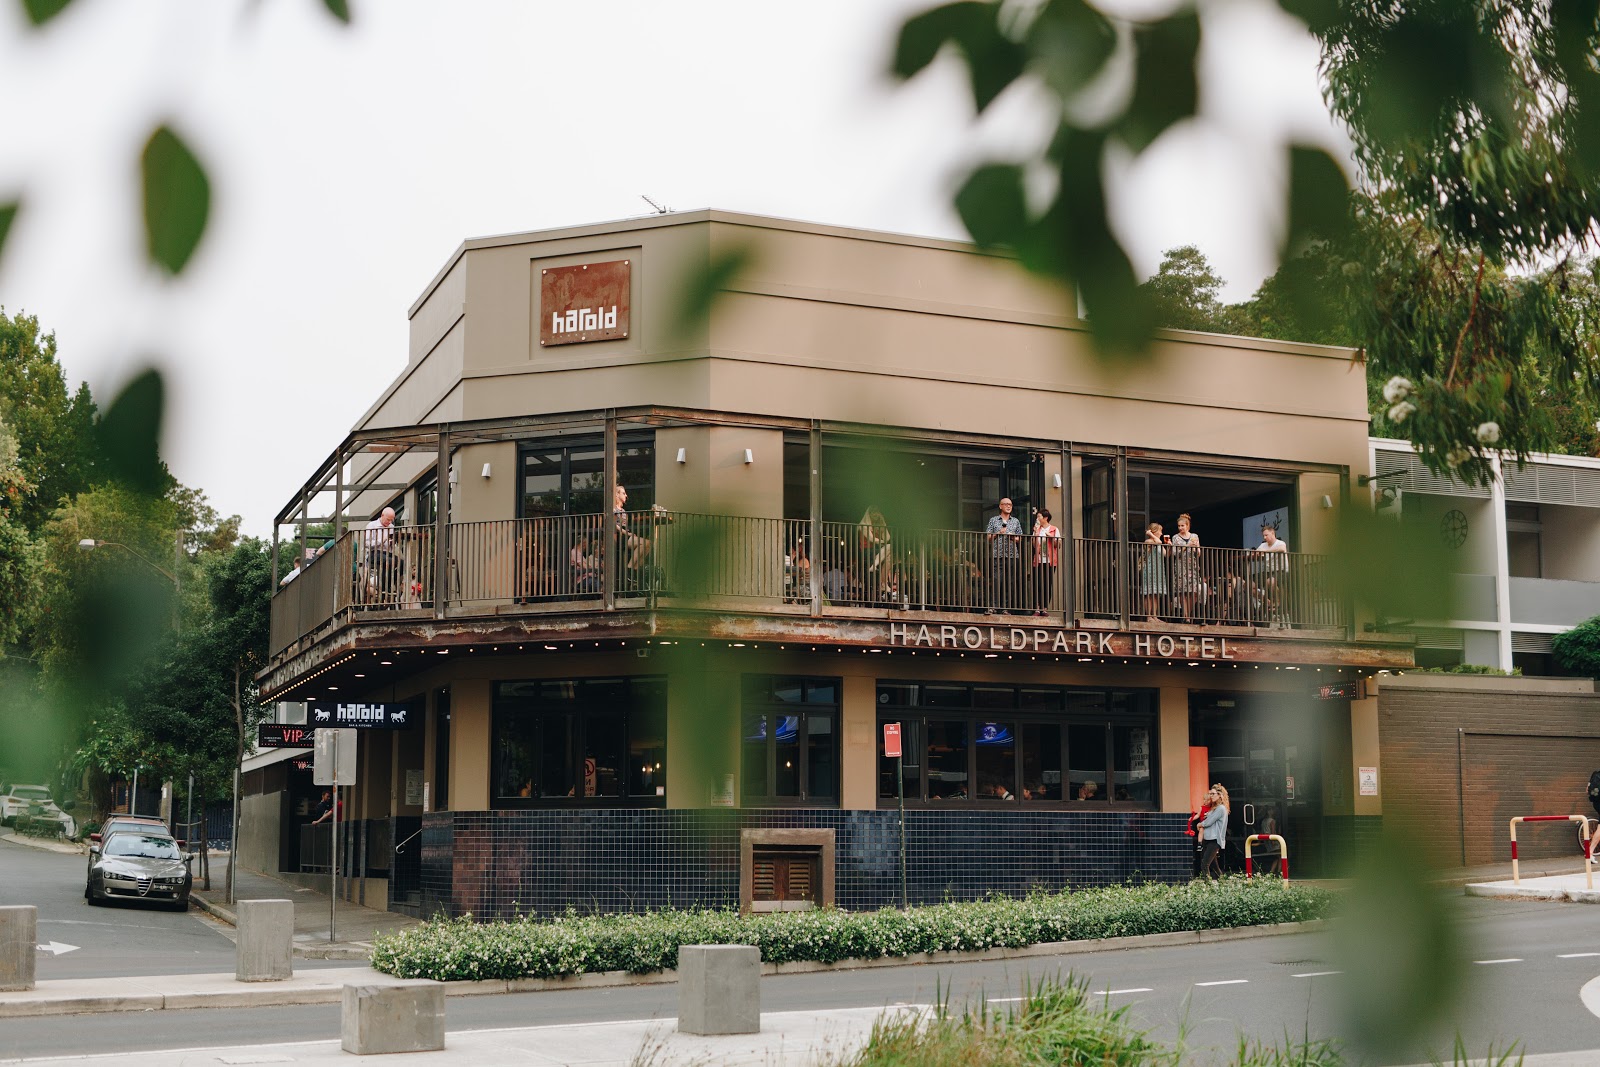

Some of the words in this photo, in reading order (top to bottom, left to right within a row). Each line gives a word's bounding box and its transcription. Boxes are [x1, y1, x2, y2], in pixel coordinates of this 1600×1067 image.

[552, 305, 617, 334] harold
[889, 622, 1115, 656] HAROLDPARK
[1134, 634, 1235, 660] HOTEL
[336, 703, 385, 720] harold
[283, 729, 303, 743] VIP
[297, 762, 307, 770] VIP
